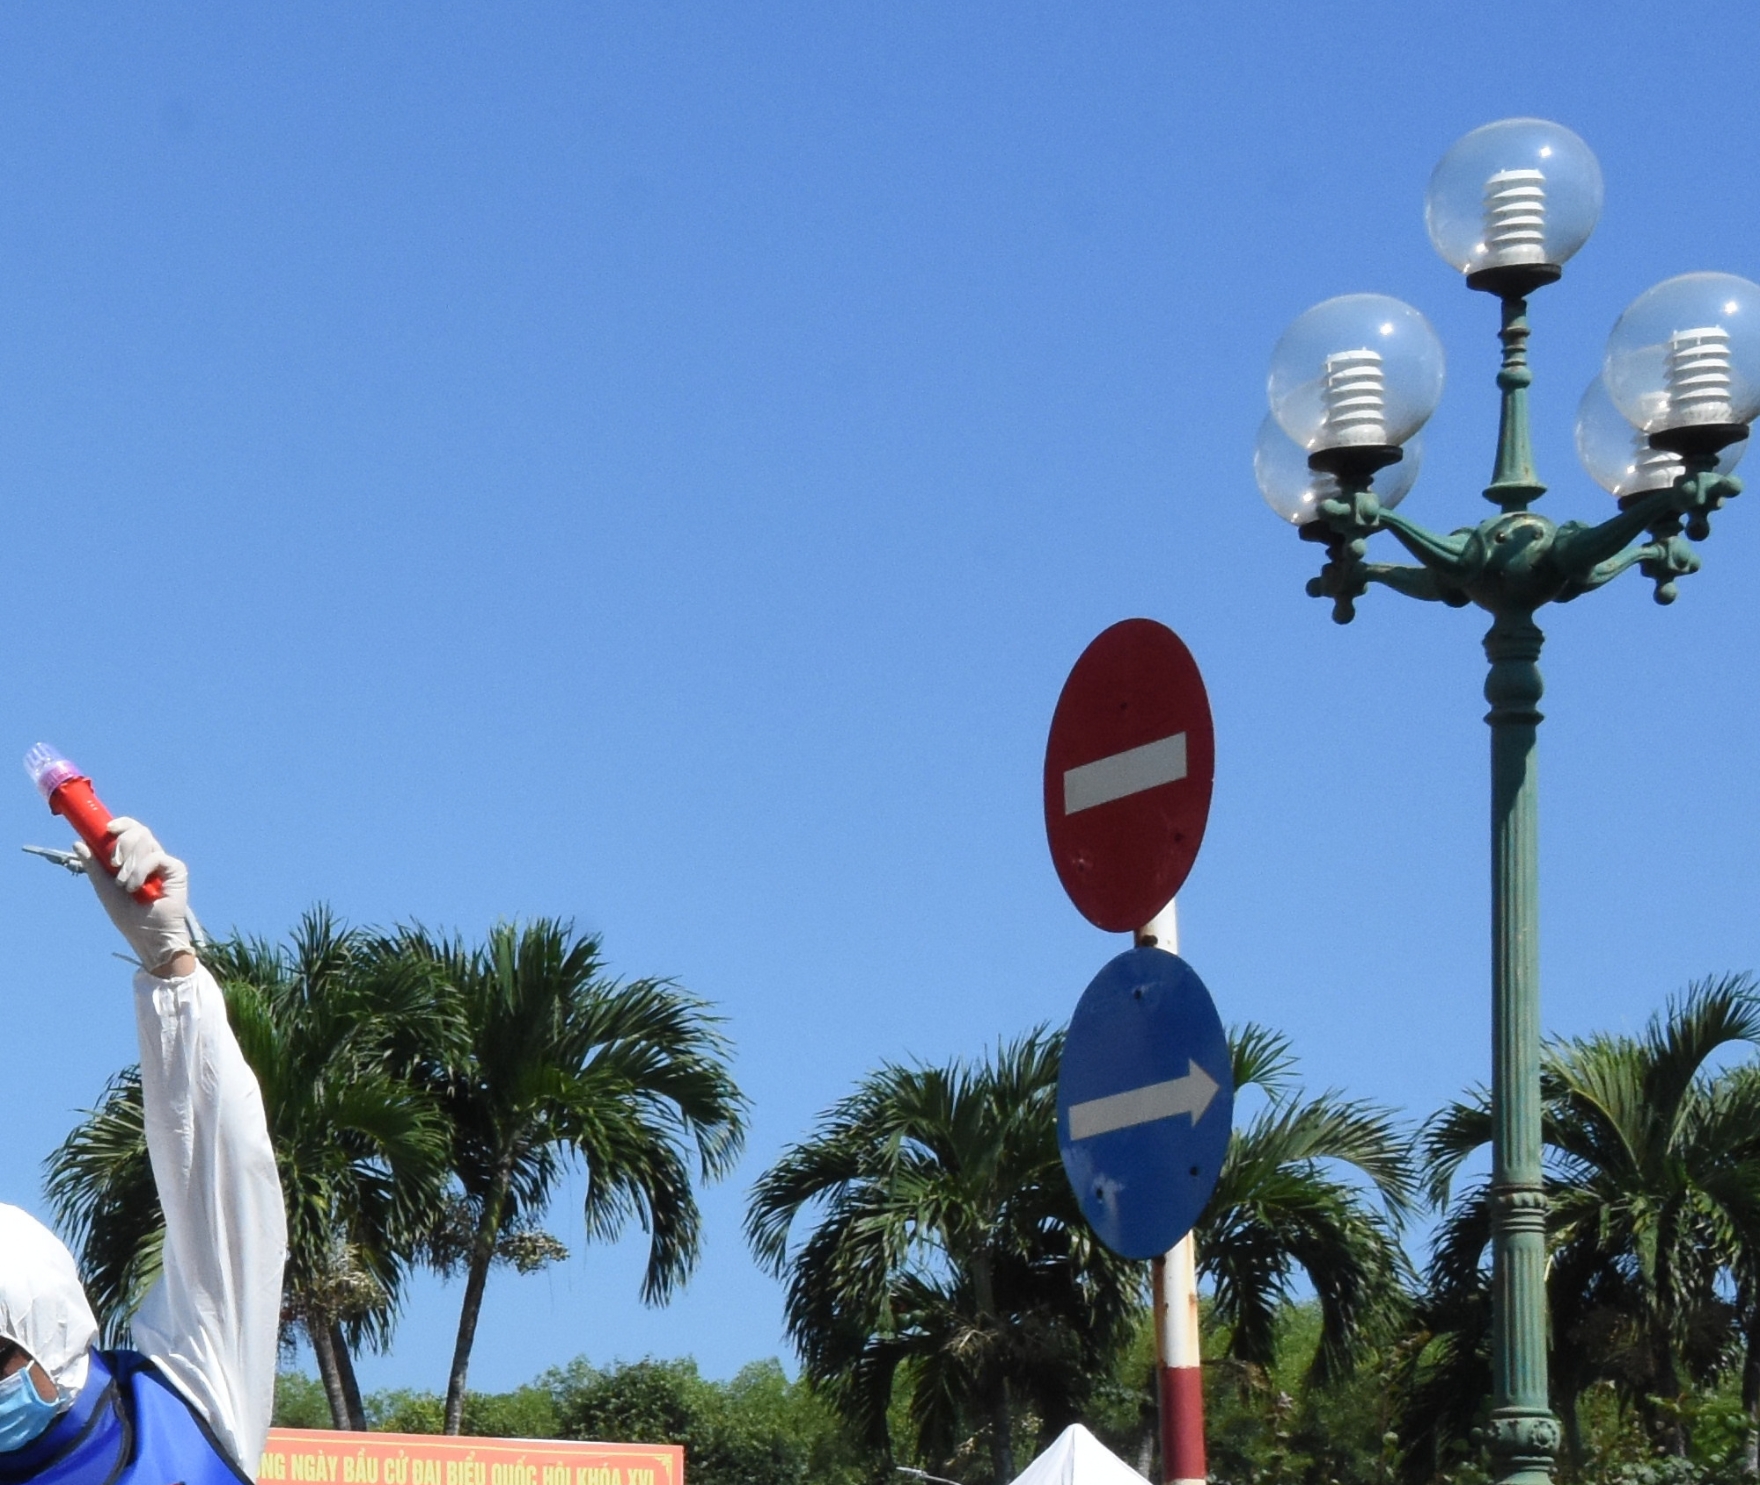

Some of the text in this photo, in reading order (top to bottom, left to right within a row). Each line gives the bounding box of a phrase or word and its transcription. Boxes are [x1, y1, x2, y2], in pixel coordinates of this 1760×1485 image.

[256, 1453, 286, 1480] NG
[291, 1449, 338, 1482] NGÀY
[343, 1447, 378, 1484] BẦU
[384, 1449, 409, 1485] CỬ
